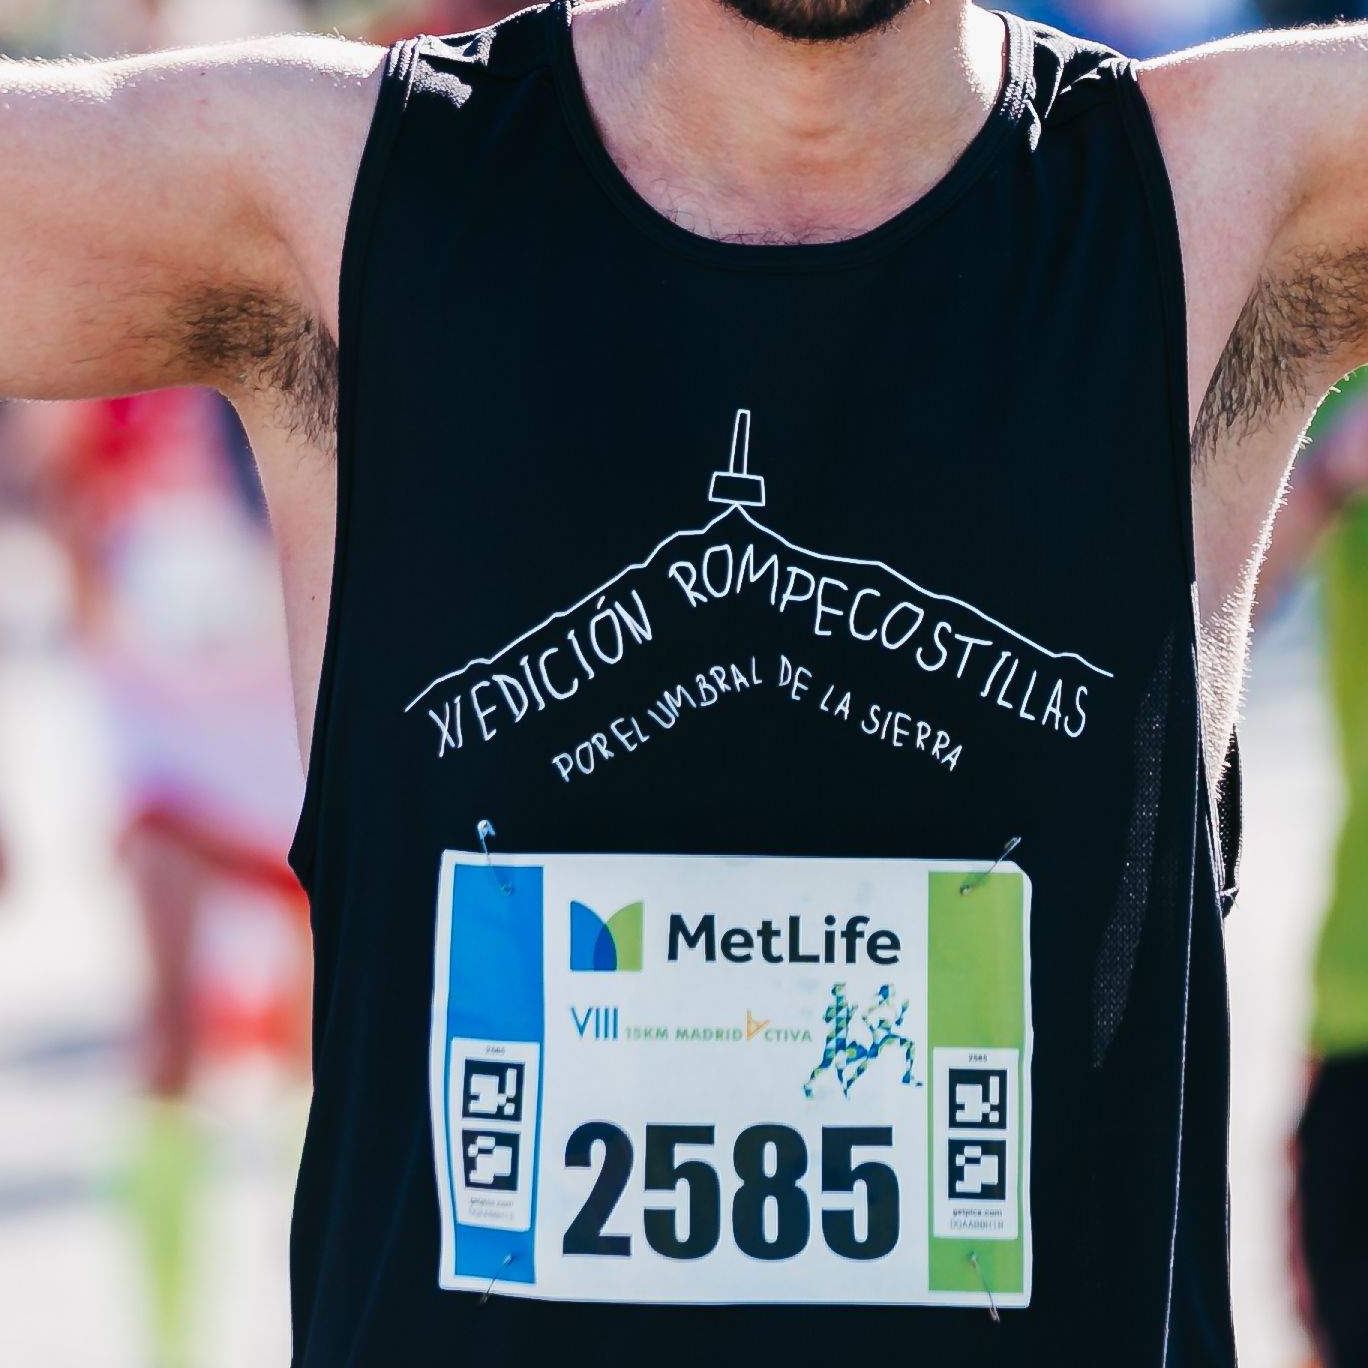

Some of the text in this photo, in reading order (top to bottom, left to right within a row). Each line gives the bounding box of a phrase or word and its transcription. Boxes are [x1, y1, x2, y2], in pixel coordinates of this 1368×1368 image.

[470, 588, 653, 742] EDICIÓN
[667, 543, 1089, 739] ROMPECOSTILLAS
[552, 654, 964, 783] POR EL UMBRAL DE LA SIERRA
[666, 914, 903, 967] MetLife
[569, 1006, 619, 1043] VIII
[674, 1026, 743, 1043] MADRID
[561, 1121, 902, 1262] 2585
